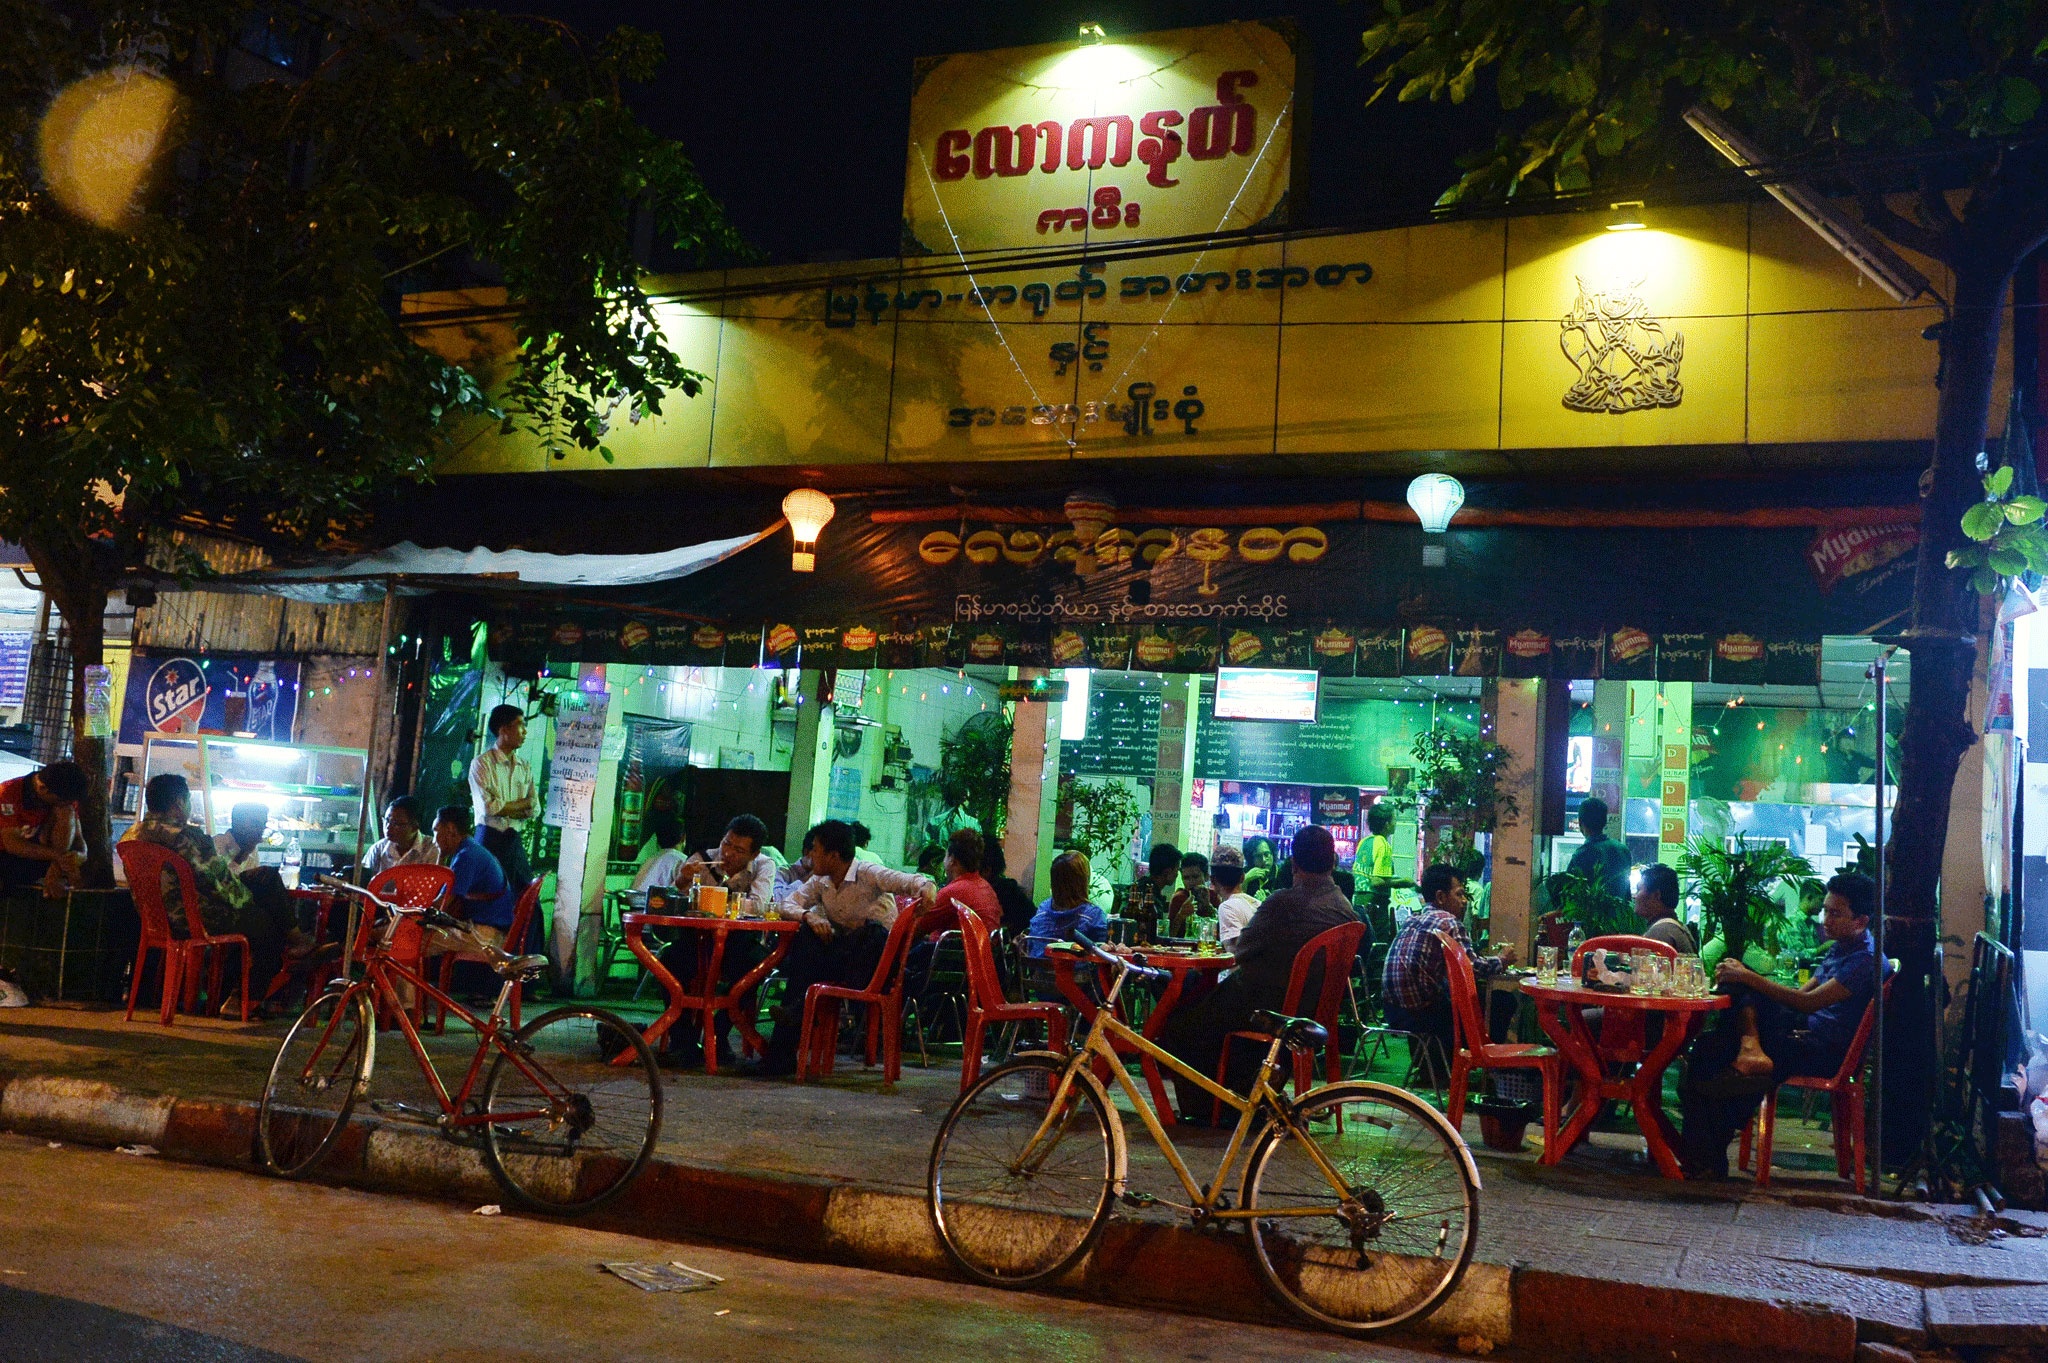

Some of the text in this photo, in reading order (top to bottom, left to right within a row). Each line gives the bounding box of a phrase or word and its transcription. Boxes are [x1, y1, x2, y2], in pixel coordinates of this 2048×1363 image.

[1049, 321, 1109, 376] နှင့်
[1109, 595, 1133, 623] နှင့်
[1144, 595, 1288, 623] စားသောက်ဆိုင်
[1314, 639, 1350, 650] Myanmar
[1509, 640, 1547, 650] Myanmar
[1719, 642, 1759, 655] Myanmar
[154, 676, 200, 720] Star
[1667, 749, 1677, 758] D
[1665, 785, 1675, 795] D
[1318, 801, 1351, 811] Myanmar
[1664, 822, 1674, 832] D
